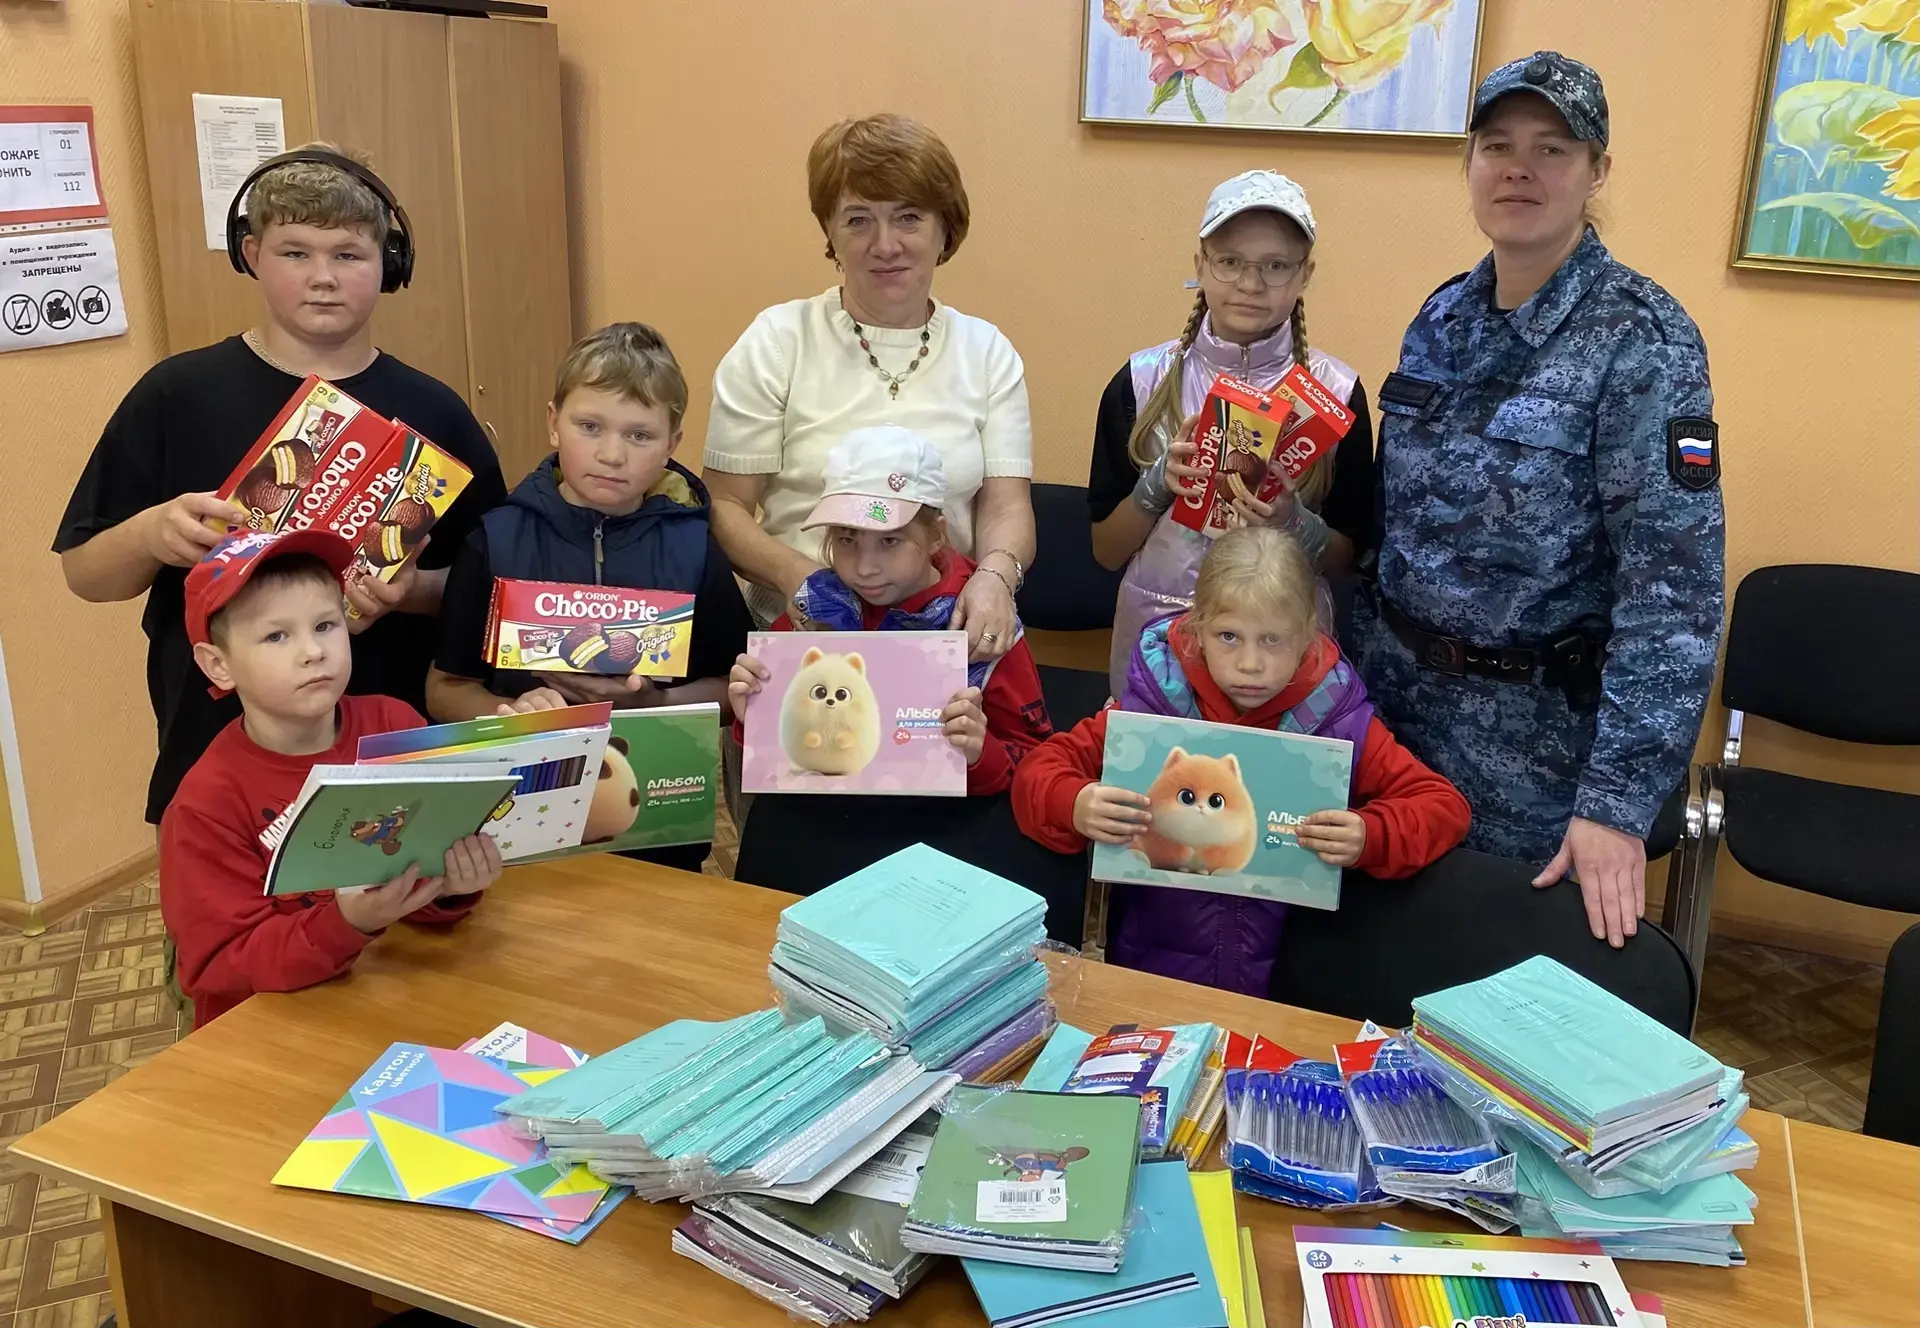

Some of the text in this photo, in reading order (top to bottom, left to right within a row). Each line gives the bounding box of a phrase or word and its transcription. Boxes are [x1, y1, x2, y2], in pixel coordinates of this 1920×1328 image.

[60, 139, 72, 149] 01
[0, 149, 40, 161] ОЖАРЕ
[0, 167, 31, 178] НИТЬ
[63, 181, 81, 191] 112
[46, 241, 88, 250] видеозапись
[10, 256, 53, 265] помещениях
[57, 251, 97, 261] учреждения
[22, 264, 82, 277] ЗАПРЕЩЕНЫ
[1232, 419, 1250, 455] Original
[1675, 425, 1713, 438] РОССИЯ
[1680, 467, 1713, 478] ФССП
[412, 462, 431, 505] Original
[317, 487, 342, 518] ORION
[337, 493, 363, 522] ORION
[247, 506, 266, 530] Orig
[584, 592, 619, 602] ORION
[636, 626, 676, 654] Original
[501, 655, 509, 666] 6
[895, 707, 942, 719] АЛЬБО
[896, 731, 909, 740] 24
[647, 775, 706, 789] АЛЬБОМ
[1267, 810, 1306, 825] АЛЬБ
[1266, 835, 1280, 844] 24
[360, 1051, 412, 1096] Картон
[390, 1052, 425, 1089] цветной
[1310, 1251, 1328, 1261] 36
